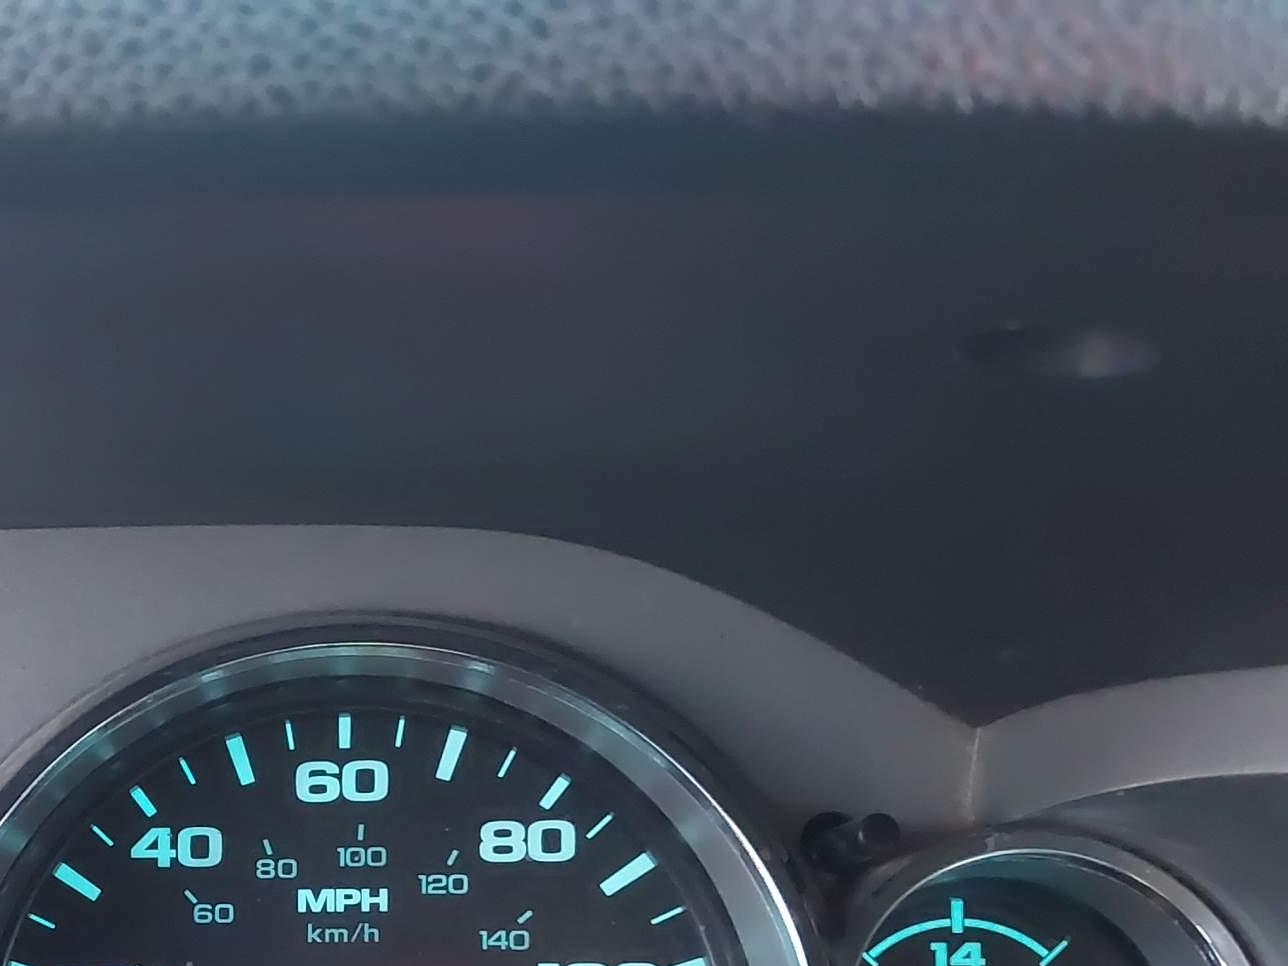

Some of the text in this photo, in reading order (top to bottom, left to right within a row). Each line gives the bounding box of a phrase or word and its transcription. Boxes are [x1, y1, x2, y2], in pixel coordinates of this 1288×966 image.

[296, 760, 388, 802] 60
[131, 827, 222, 867] 40
[480, 820, 575, 862] 80
[337, 847, 386, 866] 100
[257, 859, 297, 878] 80
[418, 874, 468, 894] 120
[298, 889, 388, 912] MPH
[192, 904, 234, 924] 60
[308, 923, 378, 942] km/h
[480, 931, 529, 950] 140
